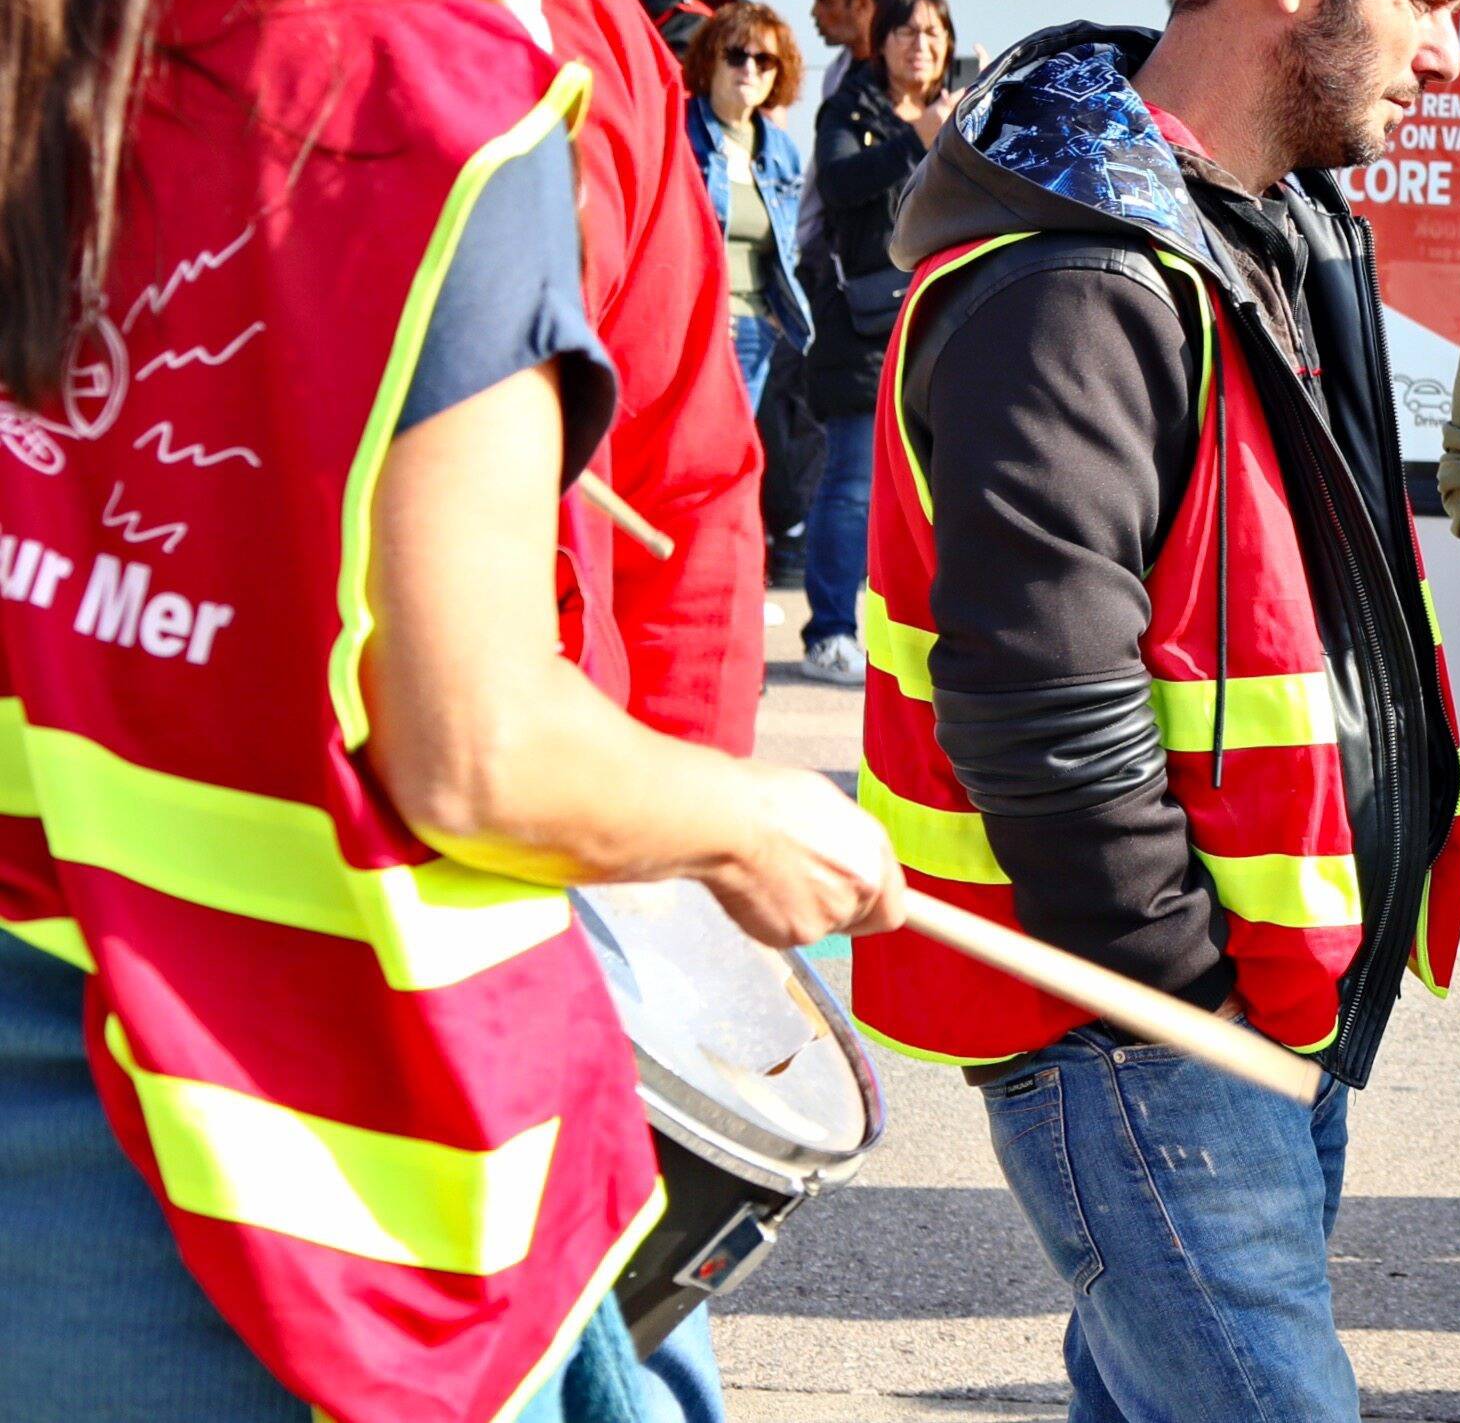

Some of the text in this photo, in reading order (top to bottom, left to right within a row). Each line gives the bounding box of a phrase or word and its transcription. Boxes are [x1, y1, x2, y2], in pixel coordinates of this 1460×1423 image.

[1400, 124, 1437, 151] ON
[1334, 159, 1452, 207] CORE
[74, 552, 235, 665] Mer
